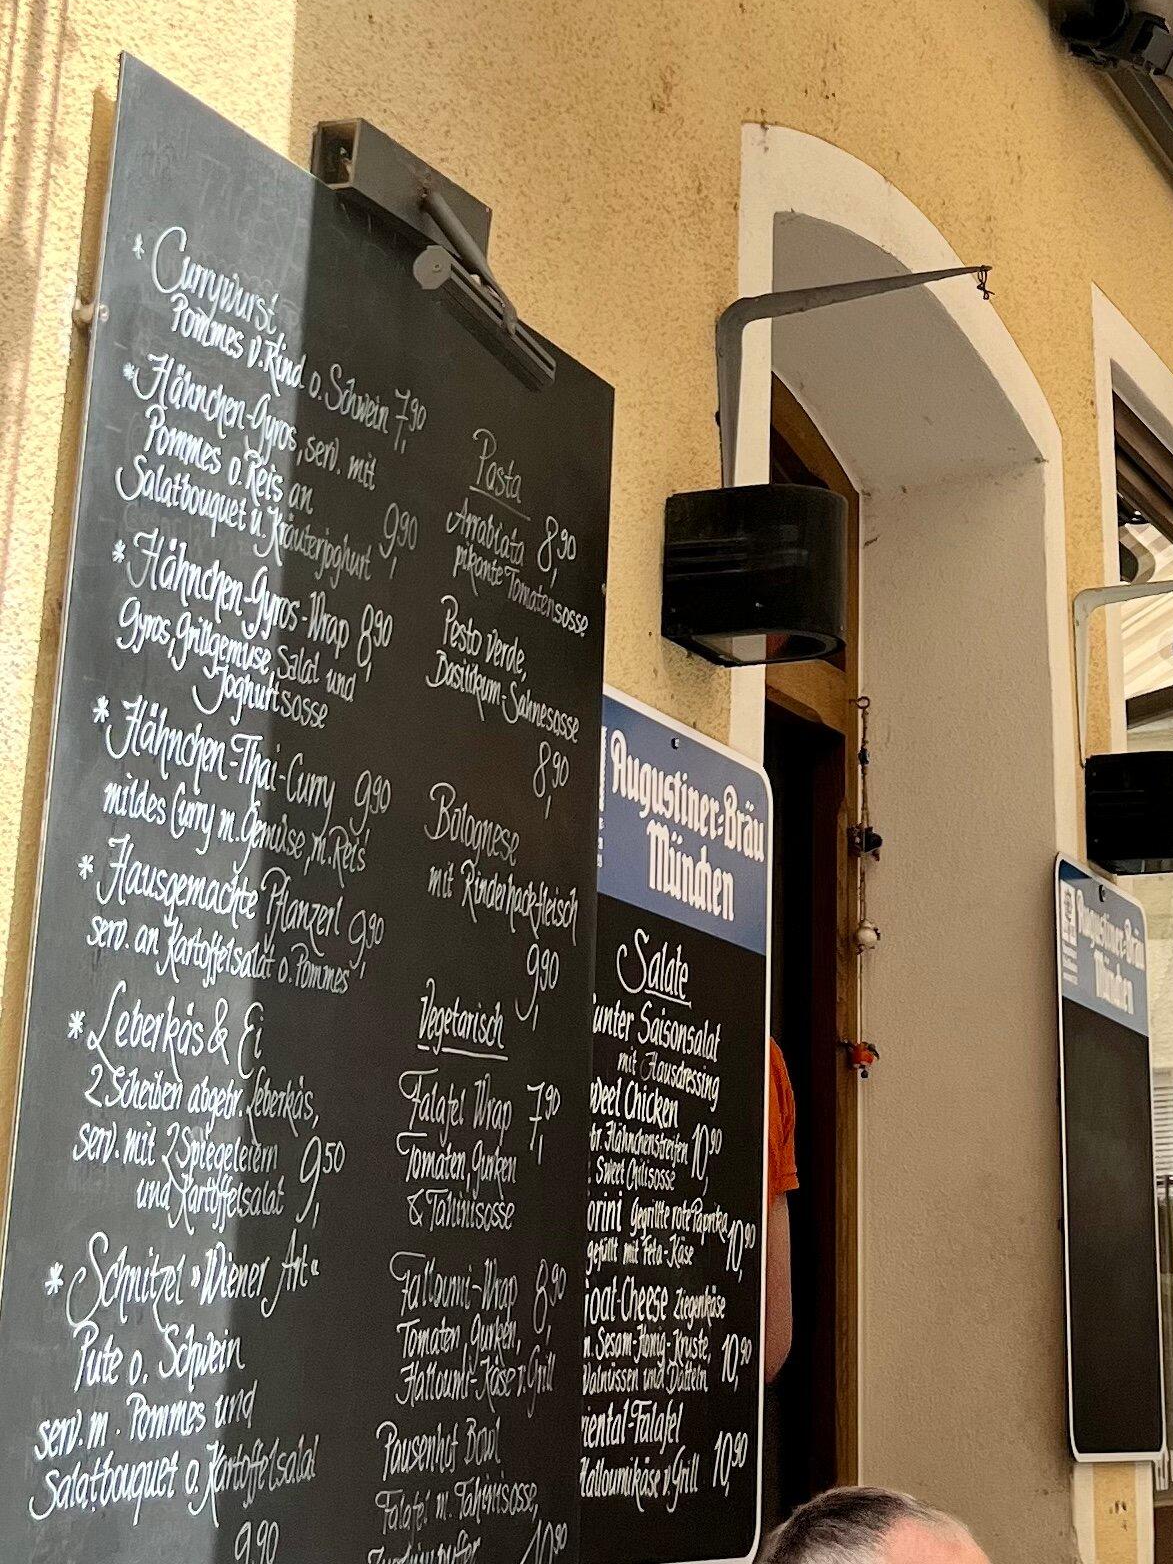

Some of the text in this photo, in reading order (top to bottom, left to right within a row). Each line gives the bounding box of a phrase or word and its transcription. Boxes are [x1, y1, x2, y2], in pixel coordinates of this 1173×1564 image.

[152, 226, 279, 335] Currywurst
[171, 293, 244, 359] Pommes
[325, 363, 388, 433] Schwein
[144, 404, 222, 475] Pommes
[289, 483, 314, 515] an
[347, 453, 377, 491] mit
[472, 428, 522, 504] Pasta
[440, 594, 482, 656] Pesto
[275, 645, 320, 685] Salat
[326, 670, 356, 702] und
[103, 773, 167, 826] mildes
[171, 782, 217, 855] Curry
[424, 782, 520, 866] Bolognese
[97, 834, 259, 929] Hausgemachte
[427, 858, 579, 947] mit Rinderhackfleisch
[646, 818, 734, 921] München
[135, 925, 160, 955] an
[290, 943, 350, 994] Pommes
[616, 928, 689, 1000] Salate
[206, 997, 230, 1065] &
[418, 977, 505, 1056] Vegetarisch
[591, 993, 722, 1063] unter Saisonsalat
[617, 1047, 637, 1076] mit
[399, 1068, 466, 1147] Falafel
[624, 1080, 679, 1130] Chicken
[123, 1122, 156, 1165] mit
[136, 1178, 171, 1210] und
[66, 1231, 186, 1332] Schnitzel
[72, 1320, 124, 1392] Pute
[158, 1323, 246, 1392] Schwein
[643, 1361, 665, 1392] und
[126, 1392, 207, 1442] Pommes
[214, 1379, 258, 1429] und
[581, 1398, 684, 1455] riental-Falafel
[28, 1450, 180, 1527] Salatbouquet
